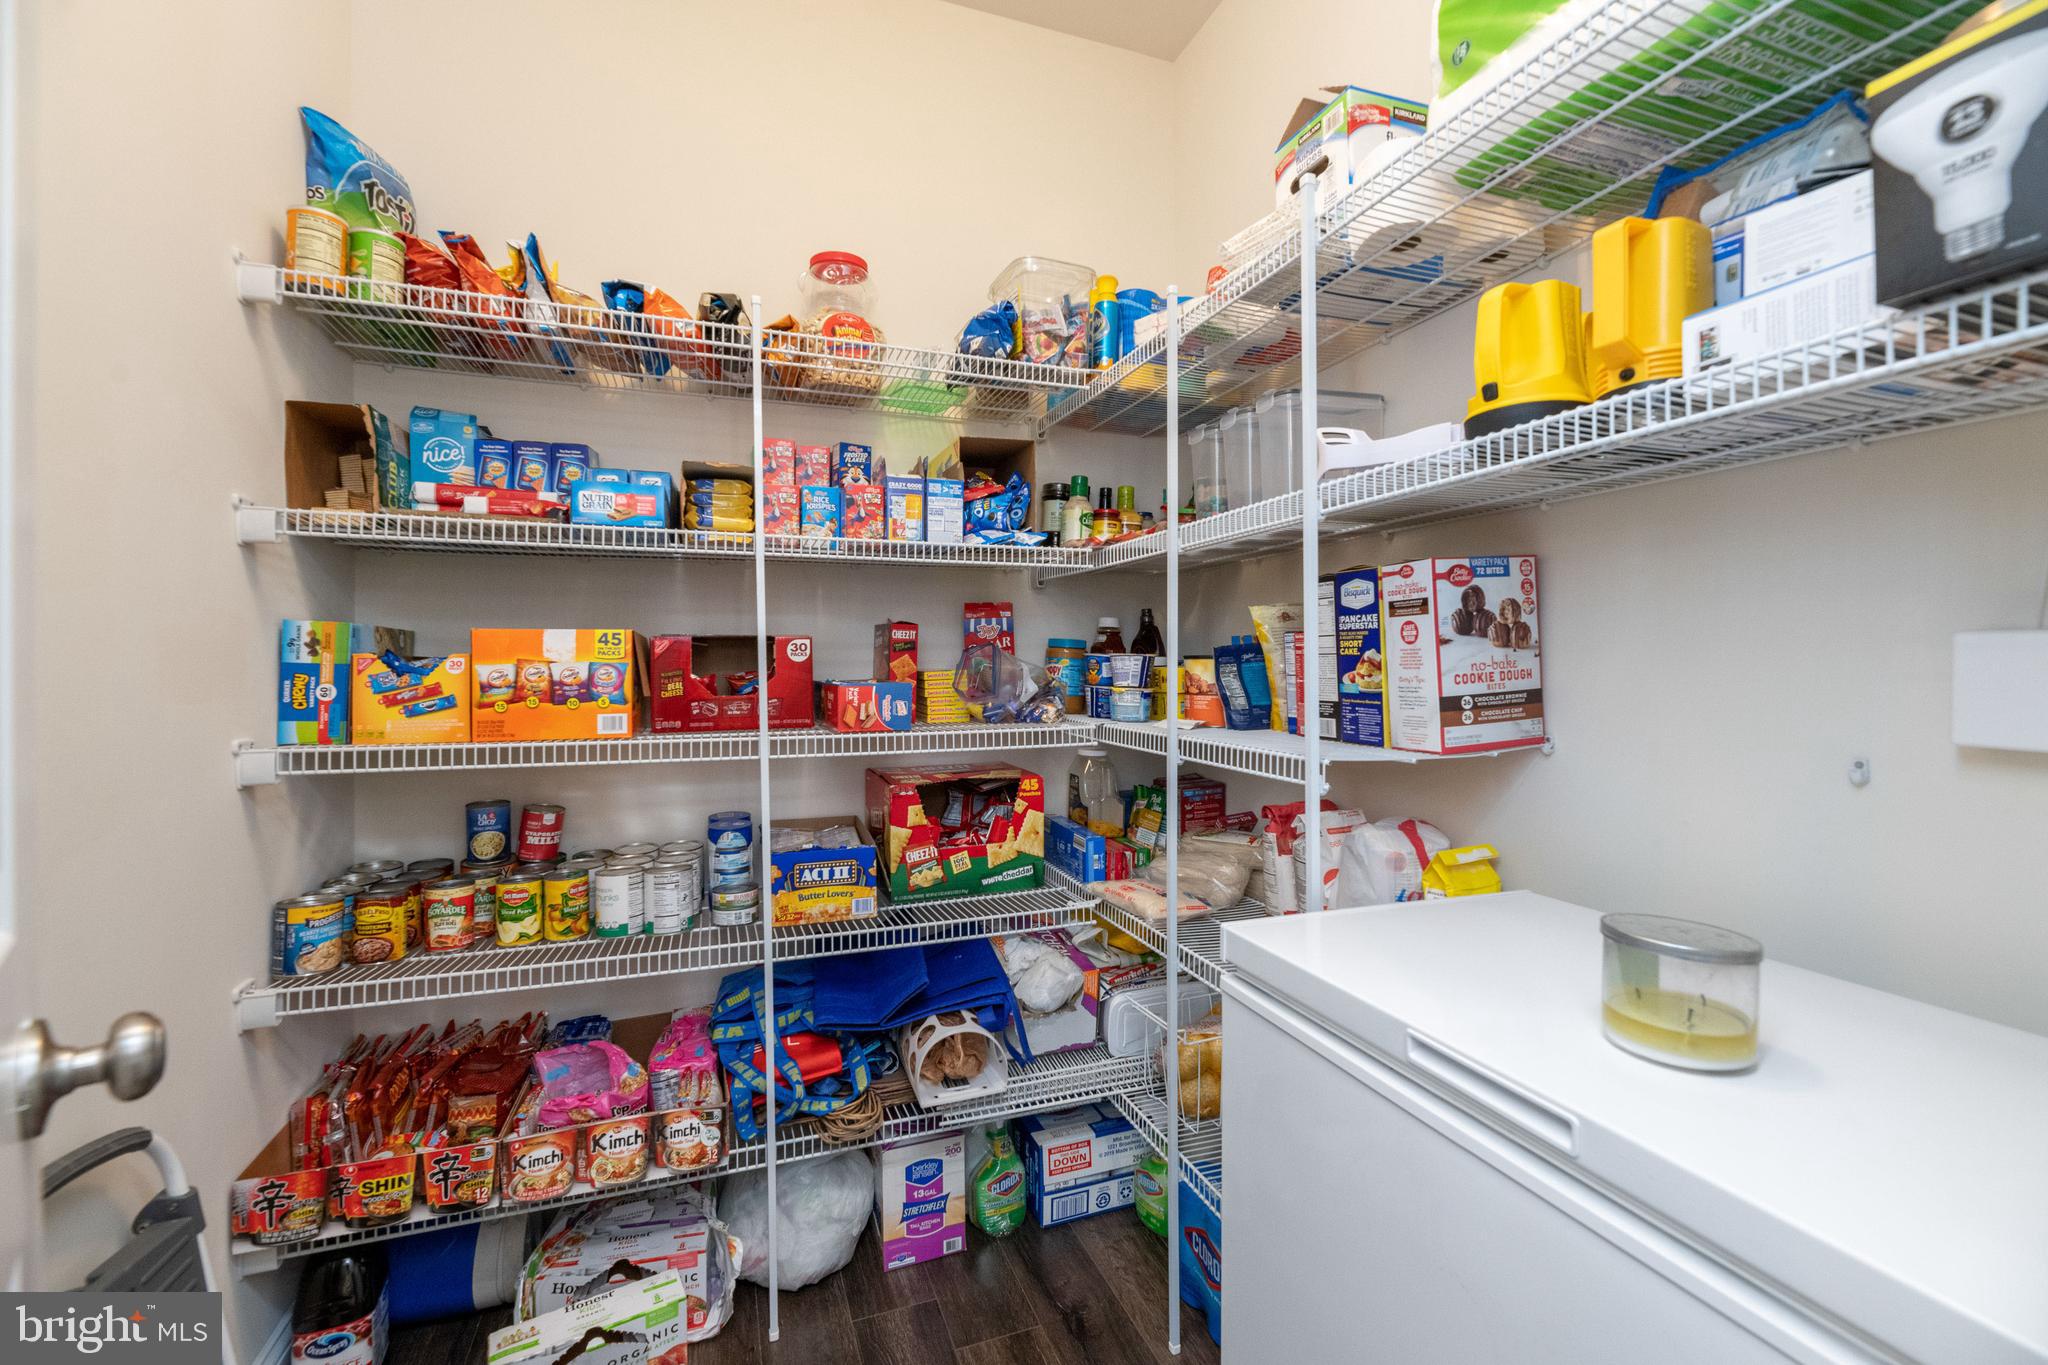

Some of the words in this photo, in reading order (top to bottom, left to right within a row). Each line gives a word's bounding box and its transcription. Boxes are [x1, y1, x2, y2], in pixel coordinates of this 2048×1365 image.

[1394, 107, 1426, 123] KIRKLAND
[1298, 122, 1321, 145] KIRKLAND
[422, 446, 465, 464] nice!
[388, 461, 399, 509] CLUB
[581, 493, 613, 501] NUTRI
[813, 496, 830, 504] RICE
[581, 500, 613, 510] GRAIN
[806, 503, 837, 512] KRISPIES
[1471, 558, 1494, 566] VARIETY
[1494, 557, 1508, 565] PACK
[1486, 566, 1505, 574] BITES
[1343, 586, 1371, 599] Bisquick
[1340, 613, 1379, 623] PANCAKE
[1338, 622, 1379, 630] SUPERSTAR
[597, 632, 622, 647] 45
[891, 630, 917, 639] CHEEZ-IT
[790, 642, 808, 652] 30
[1339, 640, 1363, 648] SHORT
[1340, 648, 1360, 656] CAKE.
[449, 660, 463, 668] 30
[1471, 654, 1518, 672] no-bake
[1454, 671, 1496, 685] COOKIE
[1499, 668, 1533, 681] DOUGH
[320, 686, 328, 698] 60
[667, 682, 683, 691] REAL
[661, 689, 684, 698] CHEESE
[852, 687, 860, 707] Variety
[1474, 695, 1505, 703] CHOCOLATE
[528, 698, 537, 706] 15
[1020, 778, 1039, 791] 45
[526, 836, 560, 845] MILK
[905, 846, 939, 864] CHEEZ-IT
[800, 867, 831, 882] ACT
[832, 865, 851, 880] II
[1002, 866, 1034, 881] cheddar
[797, 892, 825, 902] Butter
[826, 889, 854, 898] Lovers
[428, 904, 467, 917] BOYARDEE
[308, 909, 344, 929] PROGRESS
[1114, 966, 1150, 983] markets
[449, 1105, 497, 1122] MAMA
[610, 1105, 630, 1117] Top
[656, 1122, 701, 1142] Kimchi
[591, 1129, 649, 1154] Kimchi
[707, 1148, 718, 1159] 12
[945, 1146, 962, 1157] 200
[1050, 1145, 1071, 1154] BOTTOM
[1115, 1147, 1129, 1155] Made
[1134, 1143, 1145, 1151] USA
[512, 1149, 565, 1173] Kimchi
[1053, 1152, 1087, 1168] DOWN
[911, 1161, 939, 1174] berkley
[360, 1175, 412, 1196] SHIN
[465, 1180, 486, 1190] SHIN
[991, 1173, 1020, 1195] CLOROX
[474, 1187, 490, 1199] 12
[912, 1189, 925, 1199] 13
[924, 1188, 937, 1197] GAL
[903, 1199, 946, 1219] STRETCHFLEX
[607, 1230, 653, 1243] Honest
[1191, 1230, 1221, 1283] CLORO
[564, 1290, 615, 1314] Honest
